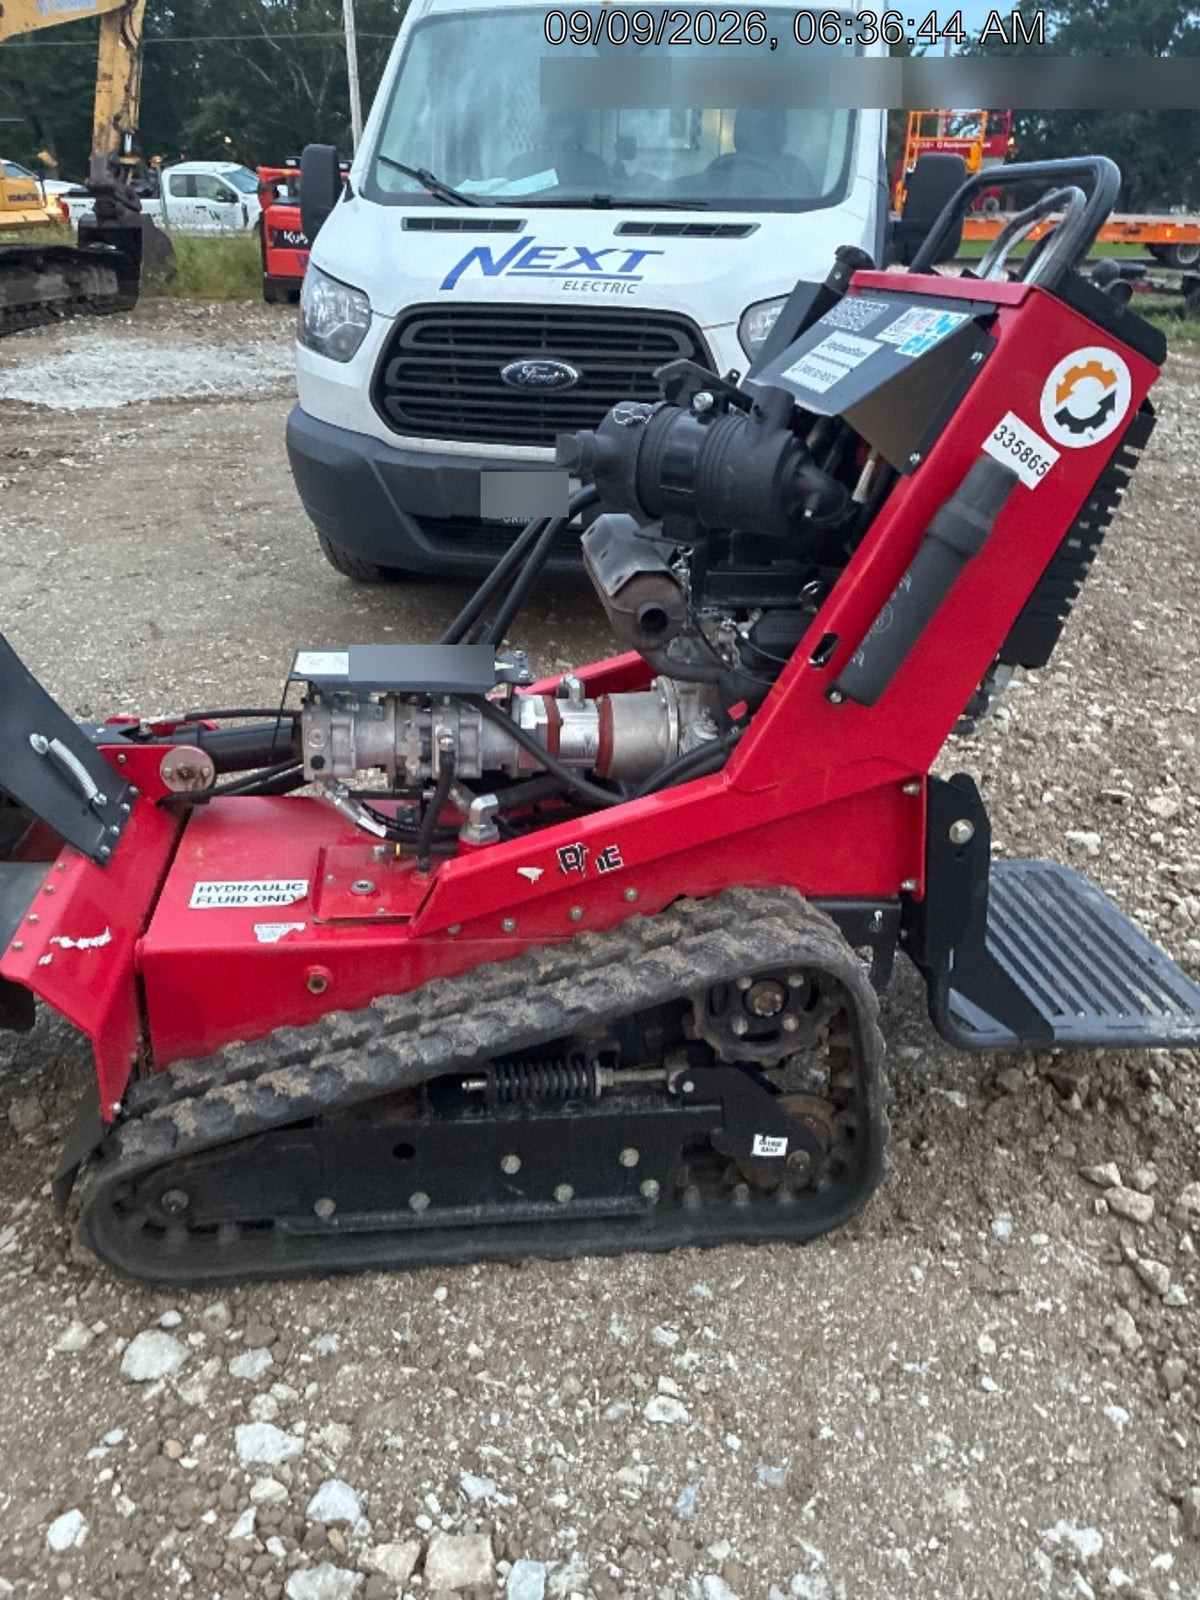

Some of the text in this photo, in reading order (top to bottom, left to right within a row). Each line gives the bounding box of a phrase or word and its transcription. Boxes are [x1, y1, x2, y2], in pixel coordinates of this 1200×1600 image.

[439, 236, 665, 290] NEXT
[562, 280, 638, 294] ELECTRIC
[993, 424, 1051, 477] 335865
[198, 883, 303, 893] HYDRAULIC
[196, 895, 248, 904] FLUID
